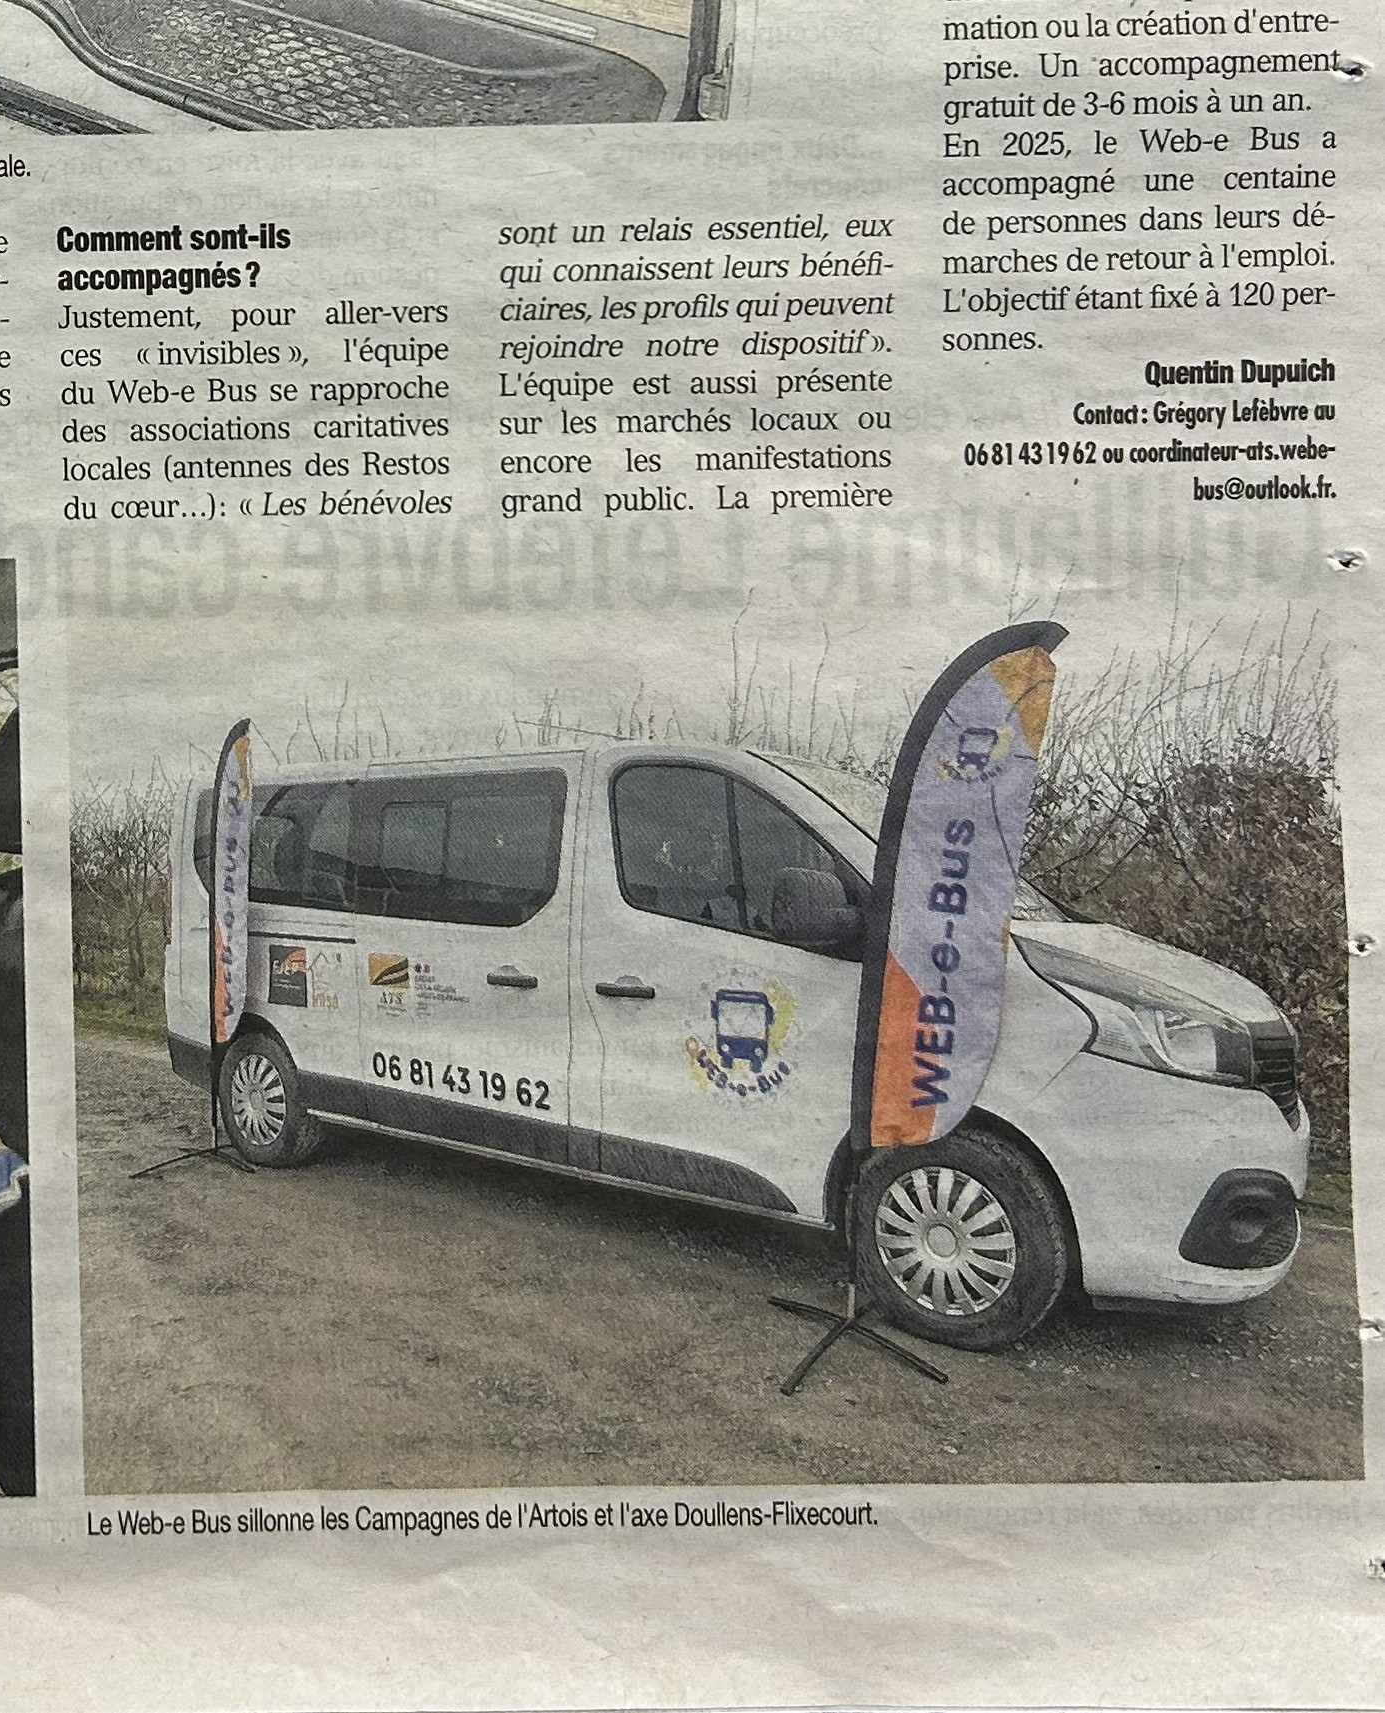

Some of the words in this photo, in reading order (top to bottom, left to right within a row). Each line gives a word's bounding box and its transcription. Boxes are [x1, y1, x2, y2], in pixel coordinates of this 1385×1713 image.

[942, 167, 1116, 201] accompagné
[1143, 172, 1195, 192] une
[1223, 163, 1337, 191] centaine
[56, 224, 183, 253] Comment
[189, 222, 291, 251] sont-ils
[57, 304, 201, 331] Justement,
[230, 307, 297, 333] pour
[325, 300, 449, 325] aller-vers
[1144, 359, 1234, 389] Quentin
[1240, 357, 1336, 389] Dupuich
[1152, 400, 1227, 430] Grégory
[1232, 397, 1309, 423] Lefèbvre
[1313, 404, 1336, 421] au
[500, 454, 592, 475] encore
[624, 447, 662, 473] les
[695, 443, 892, 472] manifestations
[1101, 447, 1124, 464] ou
[1129, 433, 1336, 464] coordinateur-ats.webe-
[1193, 473, 1337, 501] bus@outlook.fr.
[910, 818, 976, 1108] WEB-e-Bus
[372, 1051, 402, 1081] 06
[409, 1058, 434, 1089] 81
[442, 1064, 471, 1094] 43
[479, 1070, 506, 1101] 19
[516, 1077, 551, 1111] 62
[87, 1510, 113, 1536] Le
[117, 1509, 186, 1536] Web-e
[191, 1509, 232, 1534] Bus
[237, 1507, 315, 1533] sillonne
[320, 1505, 350, 1531] les
[355, 1505, 480, 1538] Campagnes
[485, 1503, 513, 1530] de
[518, 1501, 589, 1529] l'Artois
[594, 1502, 614, 1527] et
[620, 1501, 669, 1528] l'axe
[674, 1500, 878, 1527] Doullens-Flixecourt.
